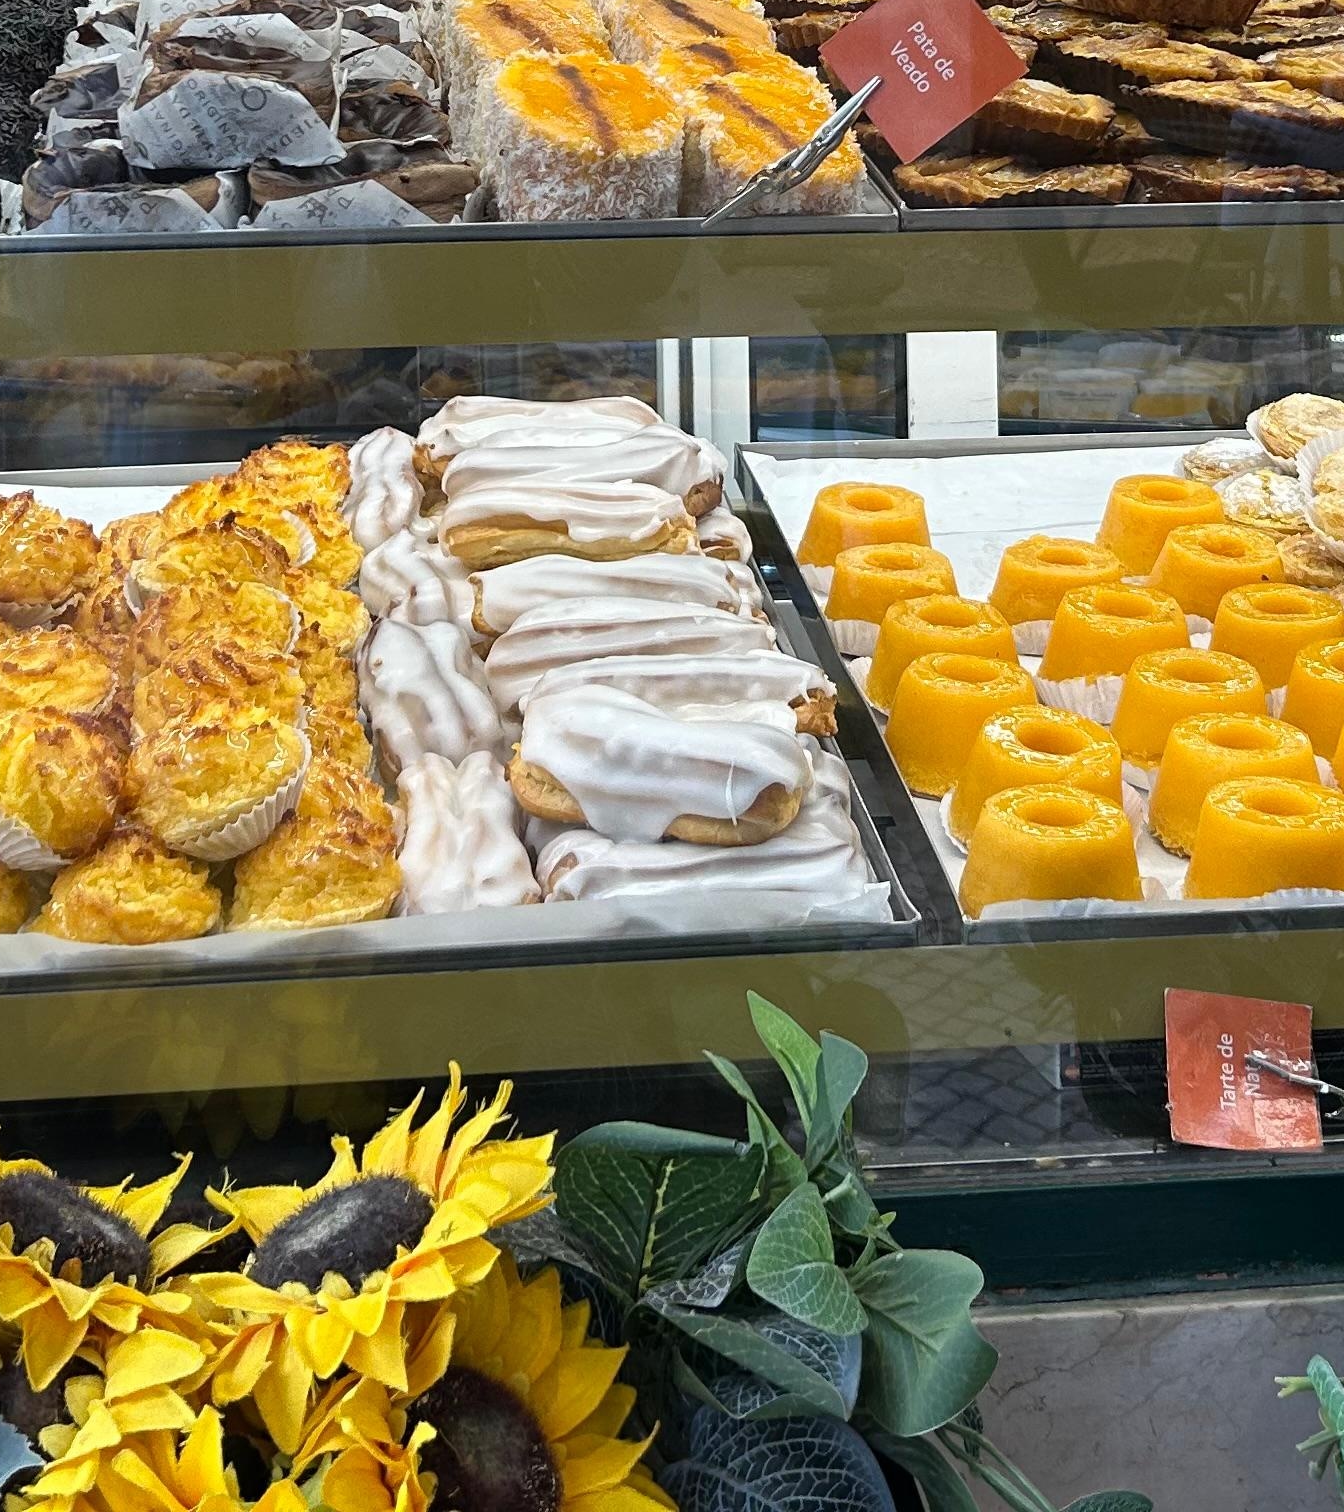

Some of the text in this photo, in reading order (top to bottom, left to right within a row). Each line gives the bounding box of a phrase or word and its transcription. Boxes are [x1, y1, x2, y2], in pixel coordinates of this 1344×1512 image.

[889, 40, 930, 93] Veado
[907, 20, 955, 81] Pata de
[1216, 1033, 1236, 1111] Tarte de
